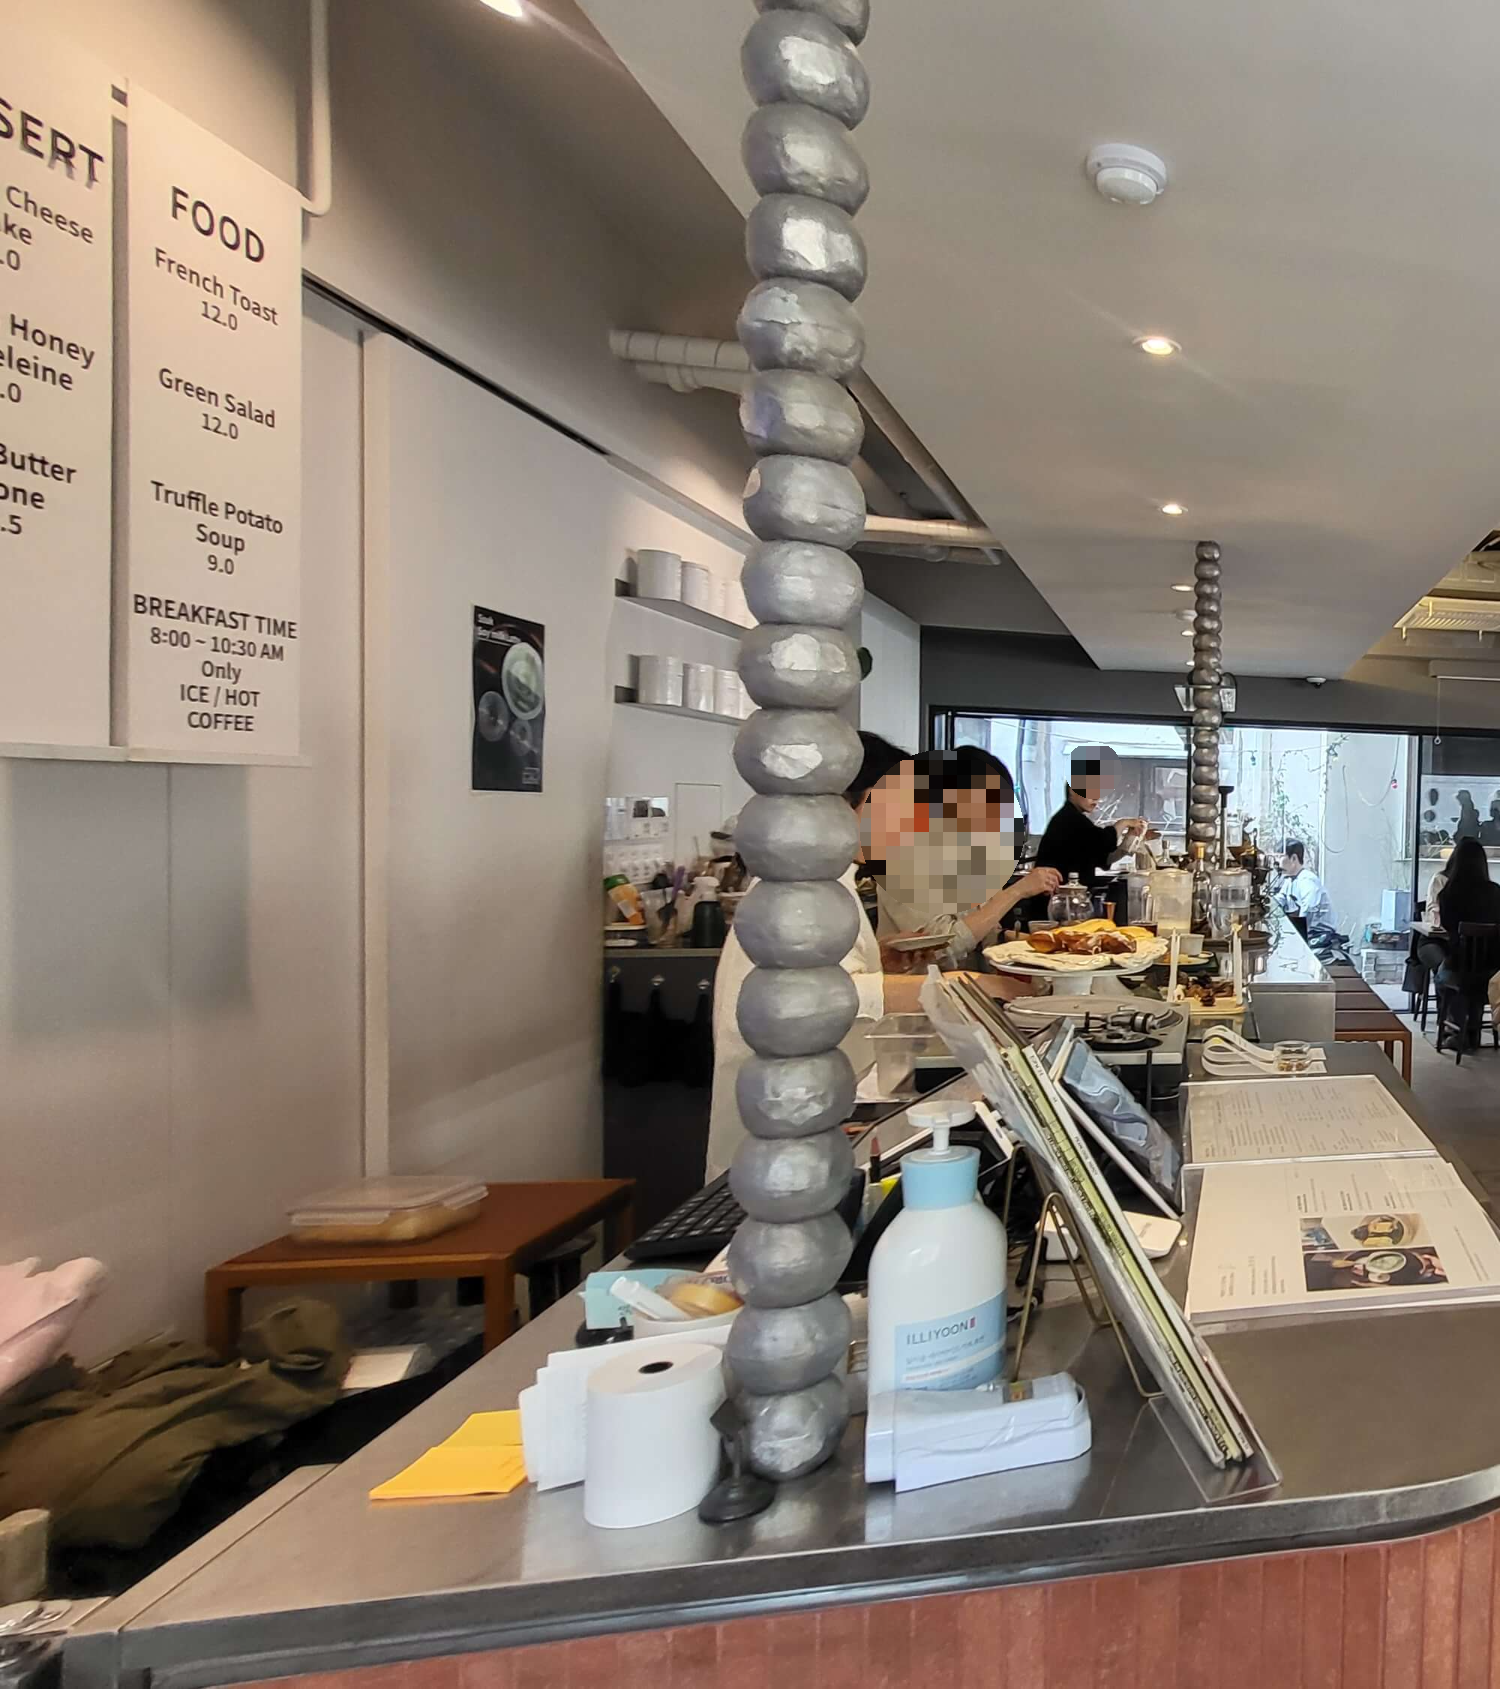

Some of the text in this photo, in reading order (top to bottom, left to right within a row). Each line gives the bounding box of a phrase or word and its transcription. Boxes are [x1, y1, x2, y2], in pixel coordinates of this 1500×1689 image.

[6, 185, 94, 244] Cheese
[171, 186, 265, 263] FOOD
[155, 247, 279, 326] French Toast
[201, 301, 238, 331] 12.0
[10, 314, 95, 370] Honey
[159, 368, 275, 428] Green Salad
[201, 413, 239, 440] 12.0
[151, 480, 283, 534] Truffle Potato
[196, 523, 246, 556] Soup
[207, 554, 235, 575] 9.0
[133, 593, 298, 639] BREAKFAST TIME
[150, 627, 191, 648] 8:00
[210, 636, 257, 658] 10:30
[260, 643, 284, 661] AM
[201, 660, 242, 685] Only
[179, 683, 210, 703] ICE
[225, 688, 261, 707] HOT
[187, 711, 255, 732] COFFEE
[906, 1319, 969, 1345] ILLIYOON
